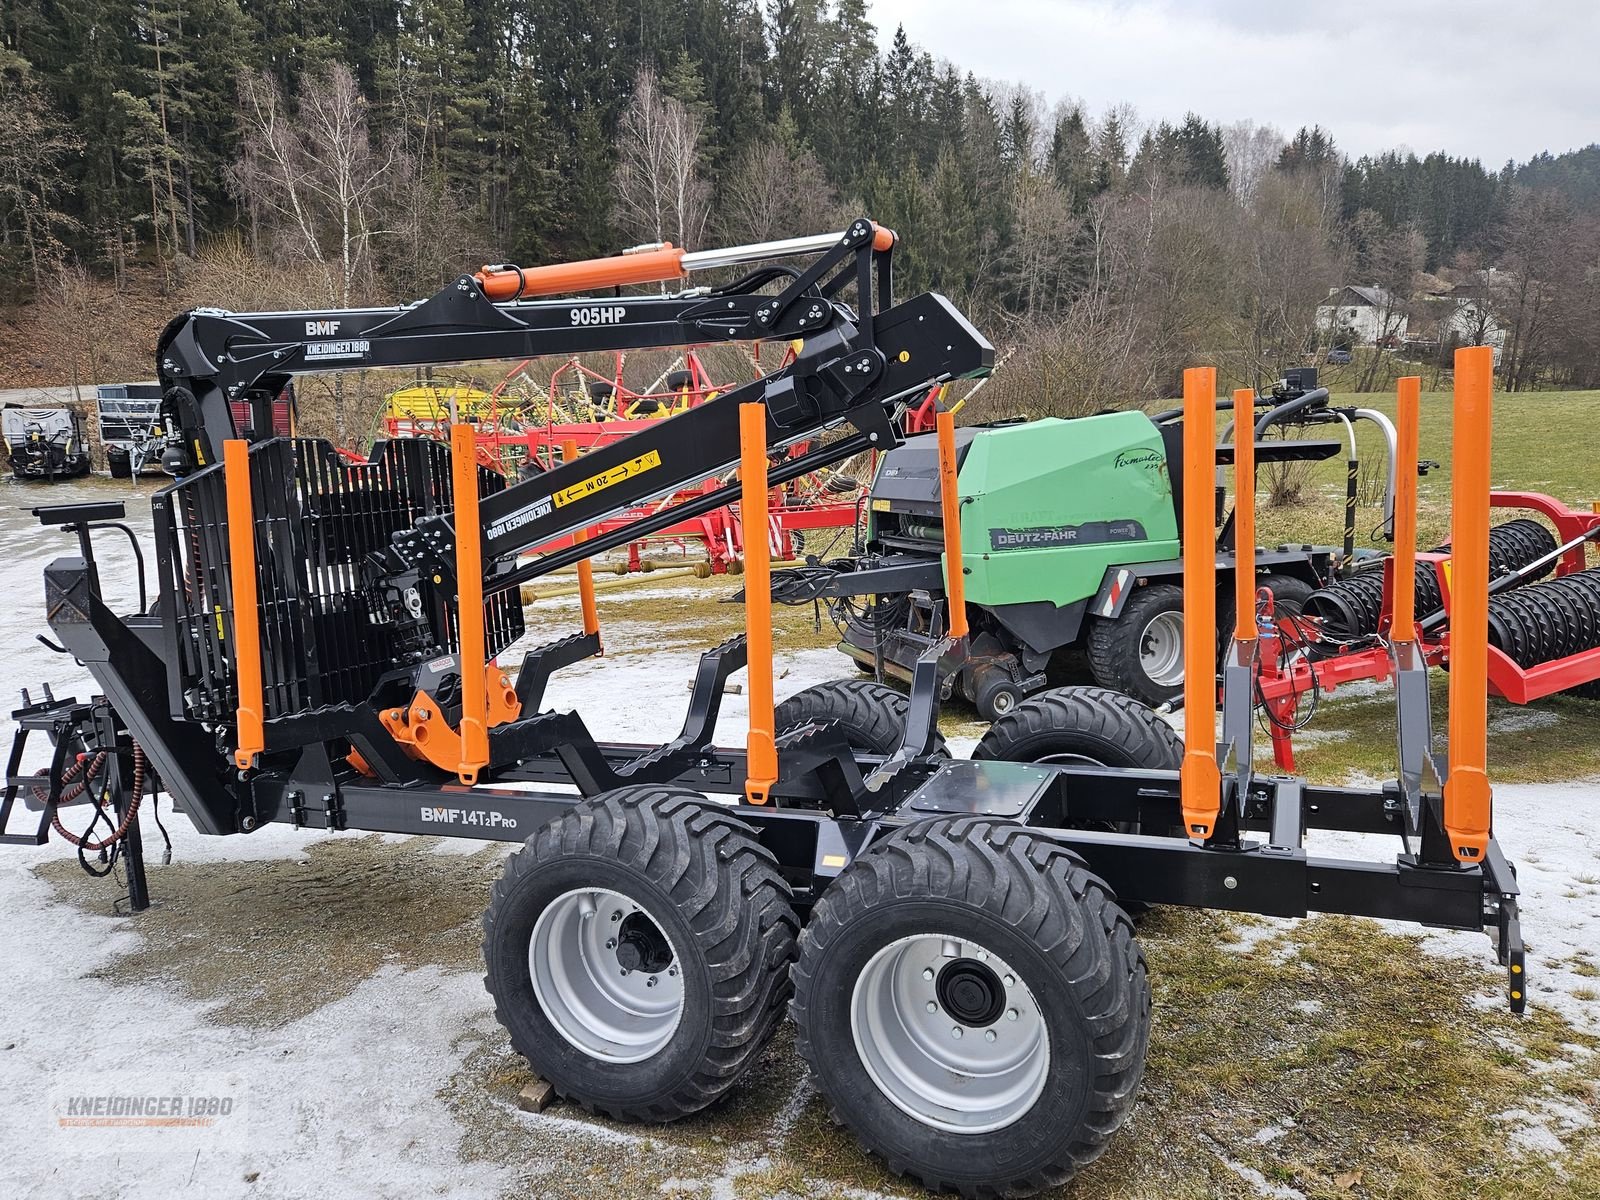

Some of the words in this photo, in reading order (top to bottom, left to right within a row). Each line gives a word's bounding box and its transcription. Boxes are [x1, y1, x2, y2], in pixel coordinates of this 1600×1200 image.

[570, 306, 626, 326] 905HP
[305, 320, 341, 336] BMF
[306, 342, 351, 355] KNEIDINGER
[351, 340, 370, 352] 1880
[585, 481, 595, 491] M
[596, 475, 609, 487] 20
[505, 502, 552, 532] KNEIDINGER
[486, 523, 507, 541] 1880
[998, 530, 1077, 545] DEUTZ-FAHR
[420, 806, 460, 823] BMF
